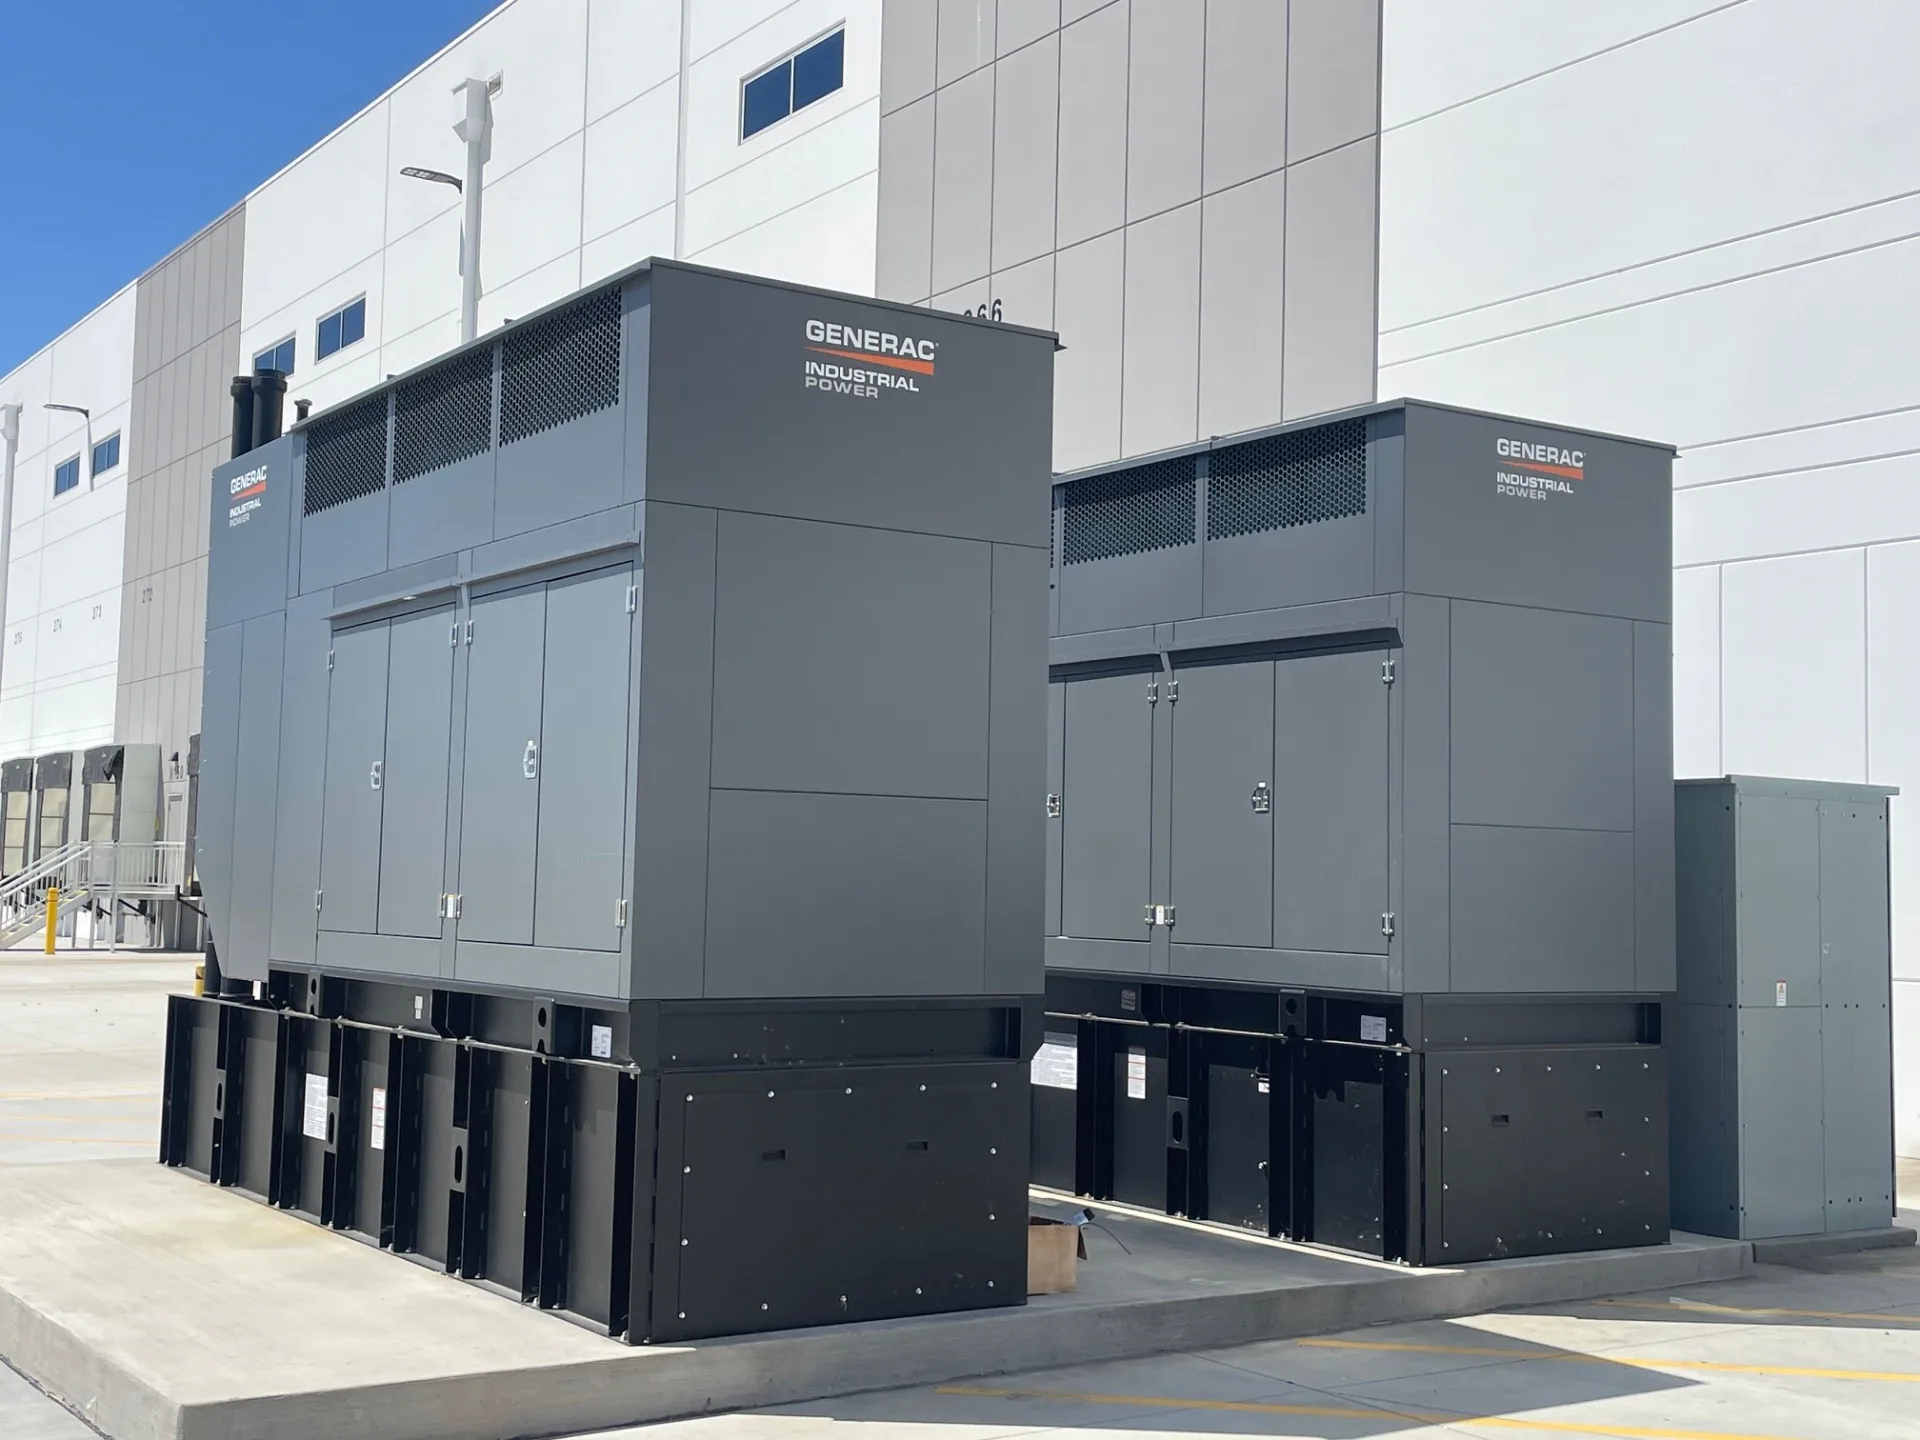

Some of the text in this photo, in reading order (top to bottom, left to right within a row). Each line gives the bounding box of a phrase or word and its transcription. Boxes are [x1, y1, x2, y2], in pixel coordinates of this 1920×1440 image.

[805, 319, 935, 361] GENERAC
[805, 360, 920, 393] INDUSTRIAL
[805, 376, 879, 399] POWER
[1496, 438, 1584, 468] GENERAC
[230, 465, 267, 494] GENERAC
[1496, 471, 1574, 494] INDUSTRIAL
[1497, 484, 1547, 501] POWER
[229, 497, 262, 518] INDUSTRIAL
[229, 512, 250, 528] POWER
